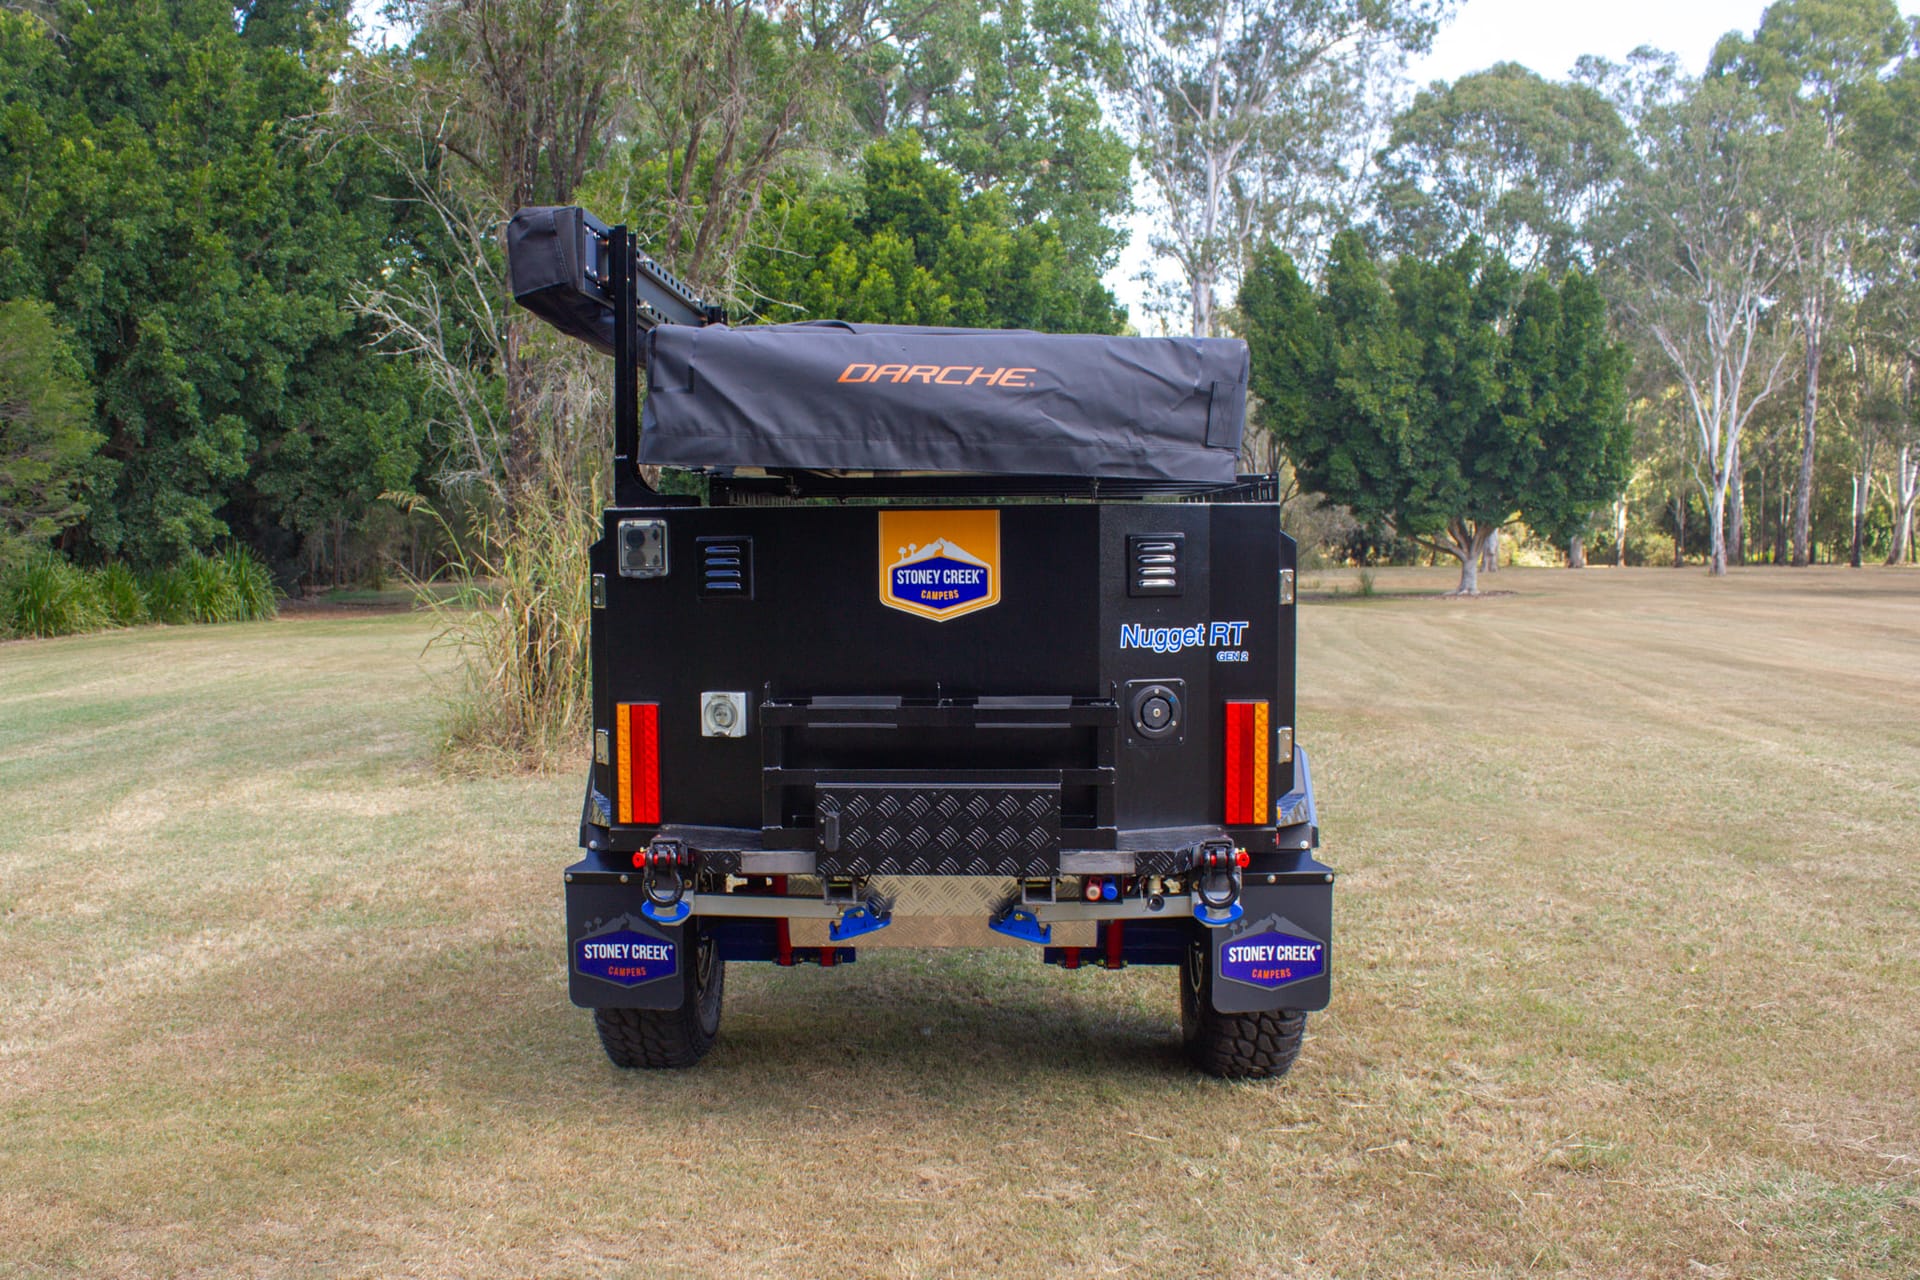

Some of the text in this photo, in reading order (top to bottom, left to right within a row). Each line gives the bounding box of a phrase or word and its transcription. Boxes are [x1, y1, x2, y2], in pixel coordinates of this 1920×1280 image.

[837, 363, 1038, 387] DARCHE
[897, 569, 980, 585] STONEY CREEK
[921, 589, 960, 601] CAMPERS
[1119, 621, 1249, 652] Nugget RT
[1216, 652, 1249, 662] GEN 2
[584, 944, 669, 961] STONEY CREEK
[1228, 945, 1316, 963] STONEY CREEK
[608, 966, 647, 977] CAMPERS
[1251, 968, 1291, 979] CAMPERS
